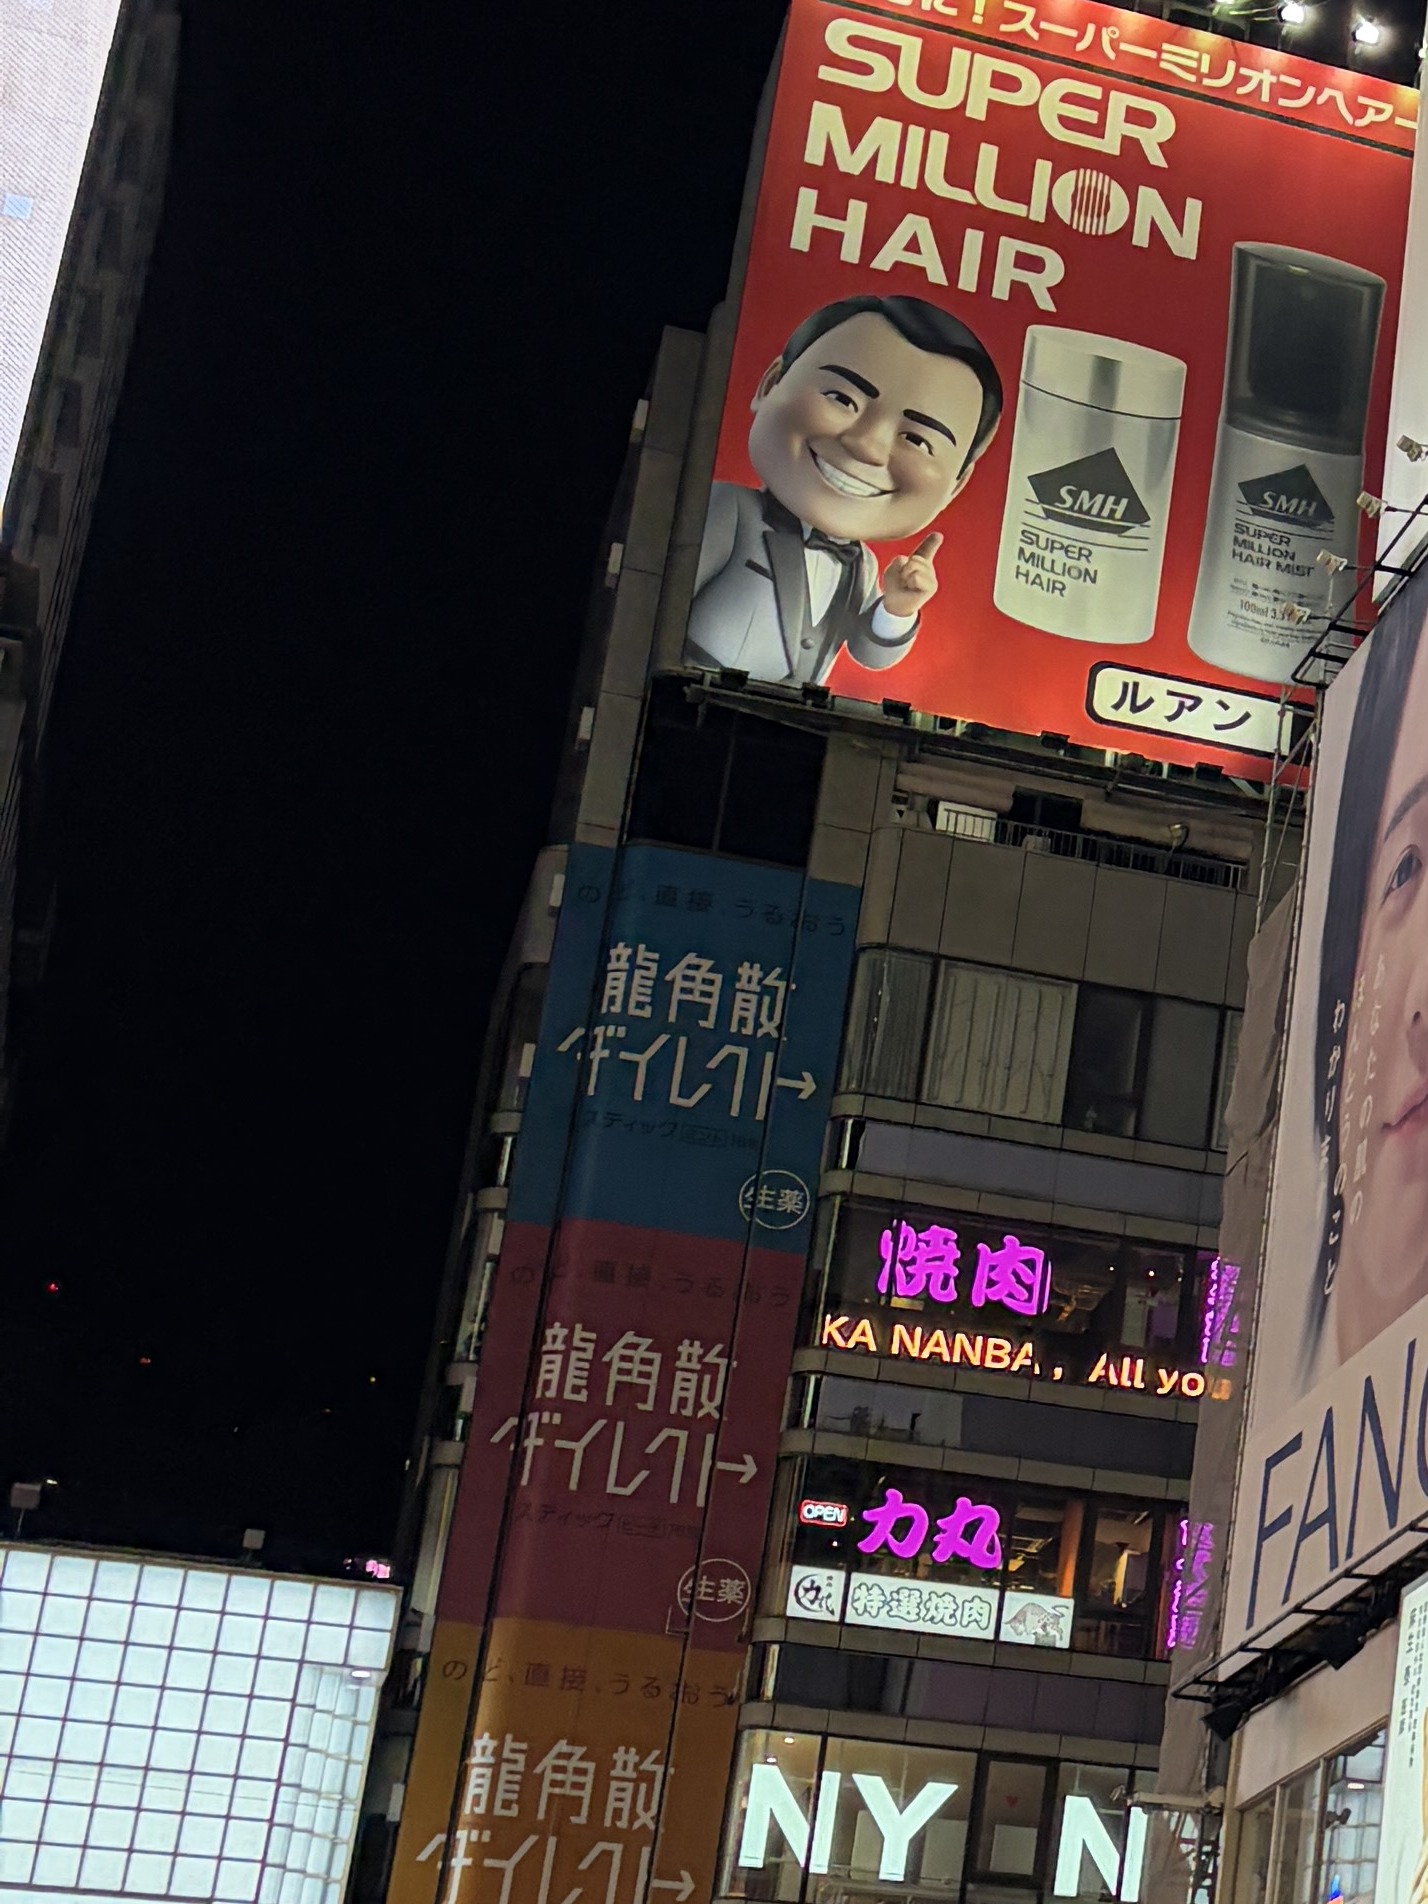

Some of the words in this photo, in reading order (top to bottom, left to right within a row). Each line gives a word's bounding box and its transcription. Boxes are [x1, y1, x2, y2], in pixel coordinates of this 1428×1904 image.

[817, 17, 1177, 169] SUPER
[804, 102, 1203, 262] MILLION
[790, 186, 1066, 314] HAIR
[1054, 485, 1128, 520] SMH
[1261, 491, 1317, 517] SMH
[1020, 529, 1093, 564] SUPER
[1233, 536, 1296, 562] MILLION
[1234, 523, 1291, 547] SUPER
[1015, 565, 1066, 598] HAIR
[1017, 547, 1098, 585] MILLION
[1231, 549, 1272, 571] HAIR
[1111, 681, 1252, 731] ルアン
[601, 940, 797, 1042] 龍角散
[878, 1219, 1050, 1316] 焼肉
[822, 1313, 877, 1353] KA
[535, 1321, 738, 1422] 龍角散
[803, 1504, 847, 1524] OPEN
[857, 1488, 1003, 1569] 力丸
[851, 1582, 993, 1631] 特選焼肉
[463, 1731, 674, 1832] 龍角散
[738, 1763, 959, 1882] NY
